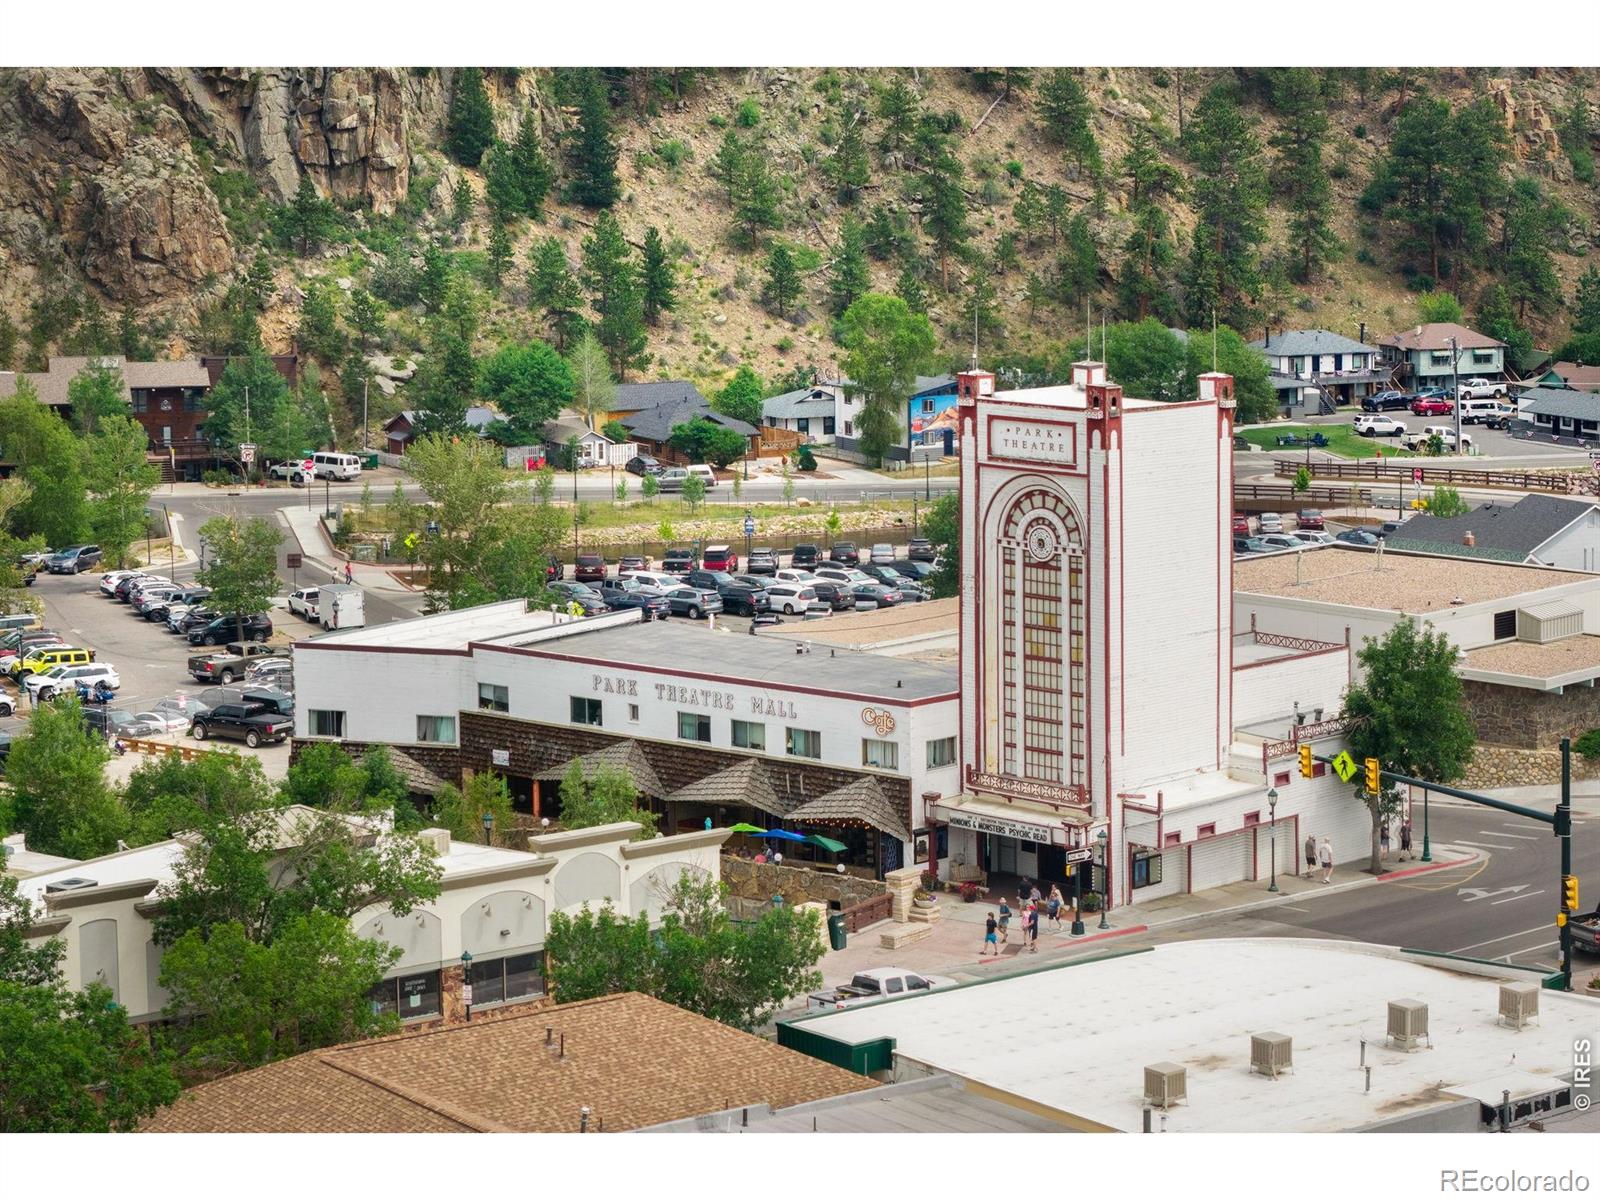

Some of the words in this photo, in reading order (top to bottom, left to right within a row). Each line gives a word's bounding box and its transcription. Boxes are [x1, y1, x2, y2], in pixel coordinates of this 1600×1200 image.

[1016, 427, 1053, 438] PARK
[1003, 439, 1064, 452] THEATRE
[592, 674, 638, 696] PARK
[655, 683, 734, 711] THEATRE
[751, 696, 797, 719] MALL
[862, 707, 896, 736] Cafe
[1009, 827, 1031, 839] PSYCHIC
